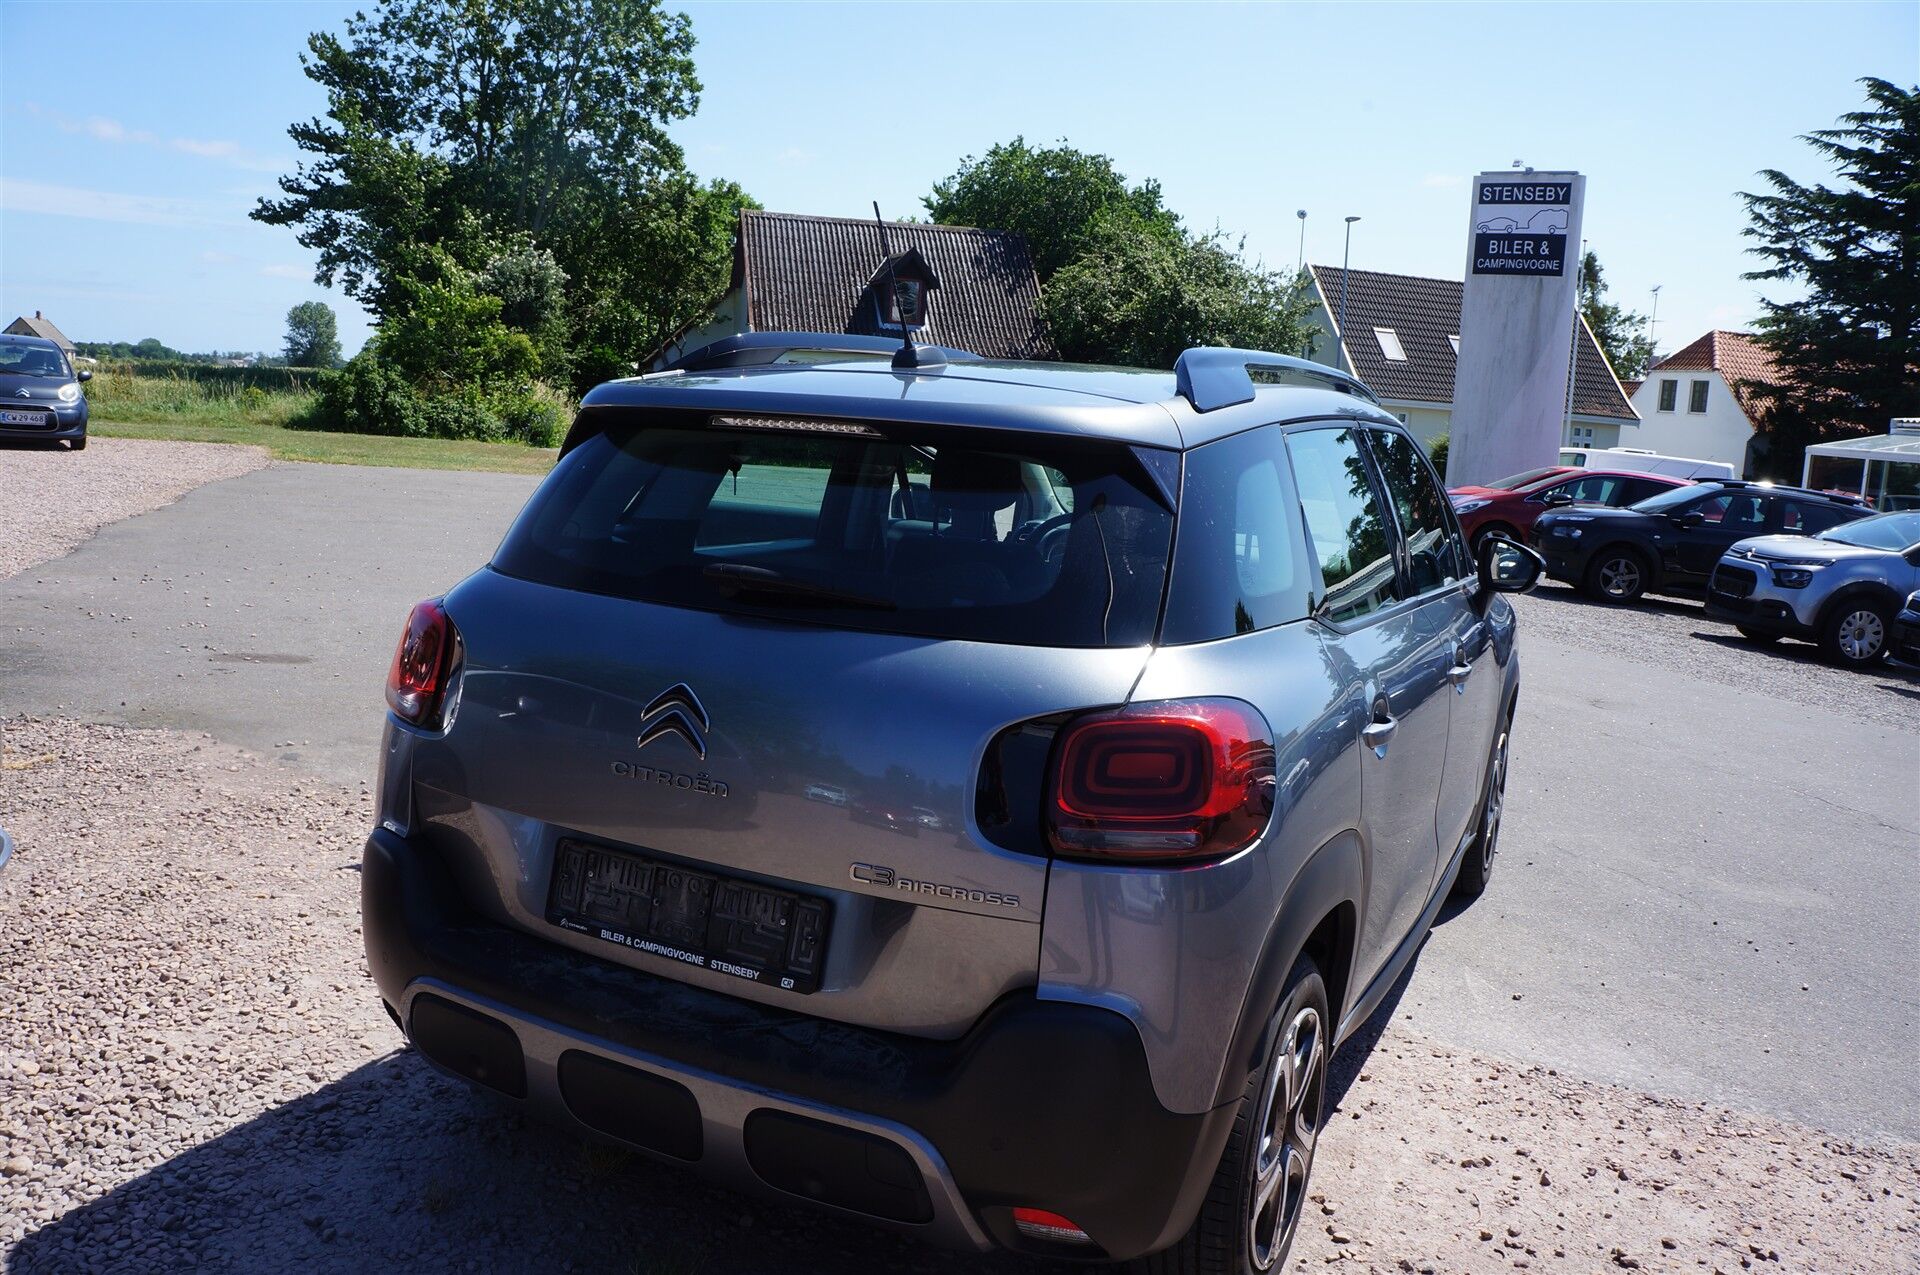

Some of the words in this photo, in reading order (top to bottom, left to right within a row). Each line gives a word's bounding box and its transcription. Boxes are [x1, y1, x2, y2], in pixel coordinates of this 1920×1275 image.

[1482, 186, 1567, 201] STENSEBY
[1488, 240, 1534, 254] BILER
[1540, 241, 1550, 255] &
[1477, 258, 1560, 270] CAMPINGVOGNE
[848, 862, 895, 888] C3
[897, 879, 1020, 908] AIRCROSS
[600, 929, 625, 944] BILER
[626, 936, 633, 946] &
[633, 938, 705, 966] CAMPINGVOGNE
[711, 960, 760, 980] STENSEBY
